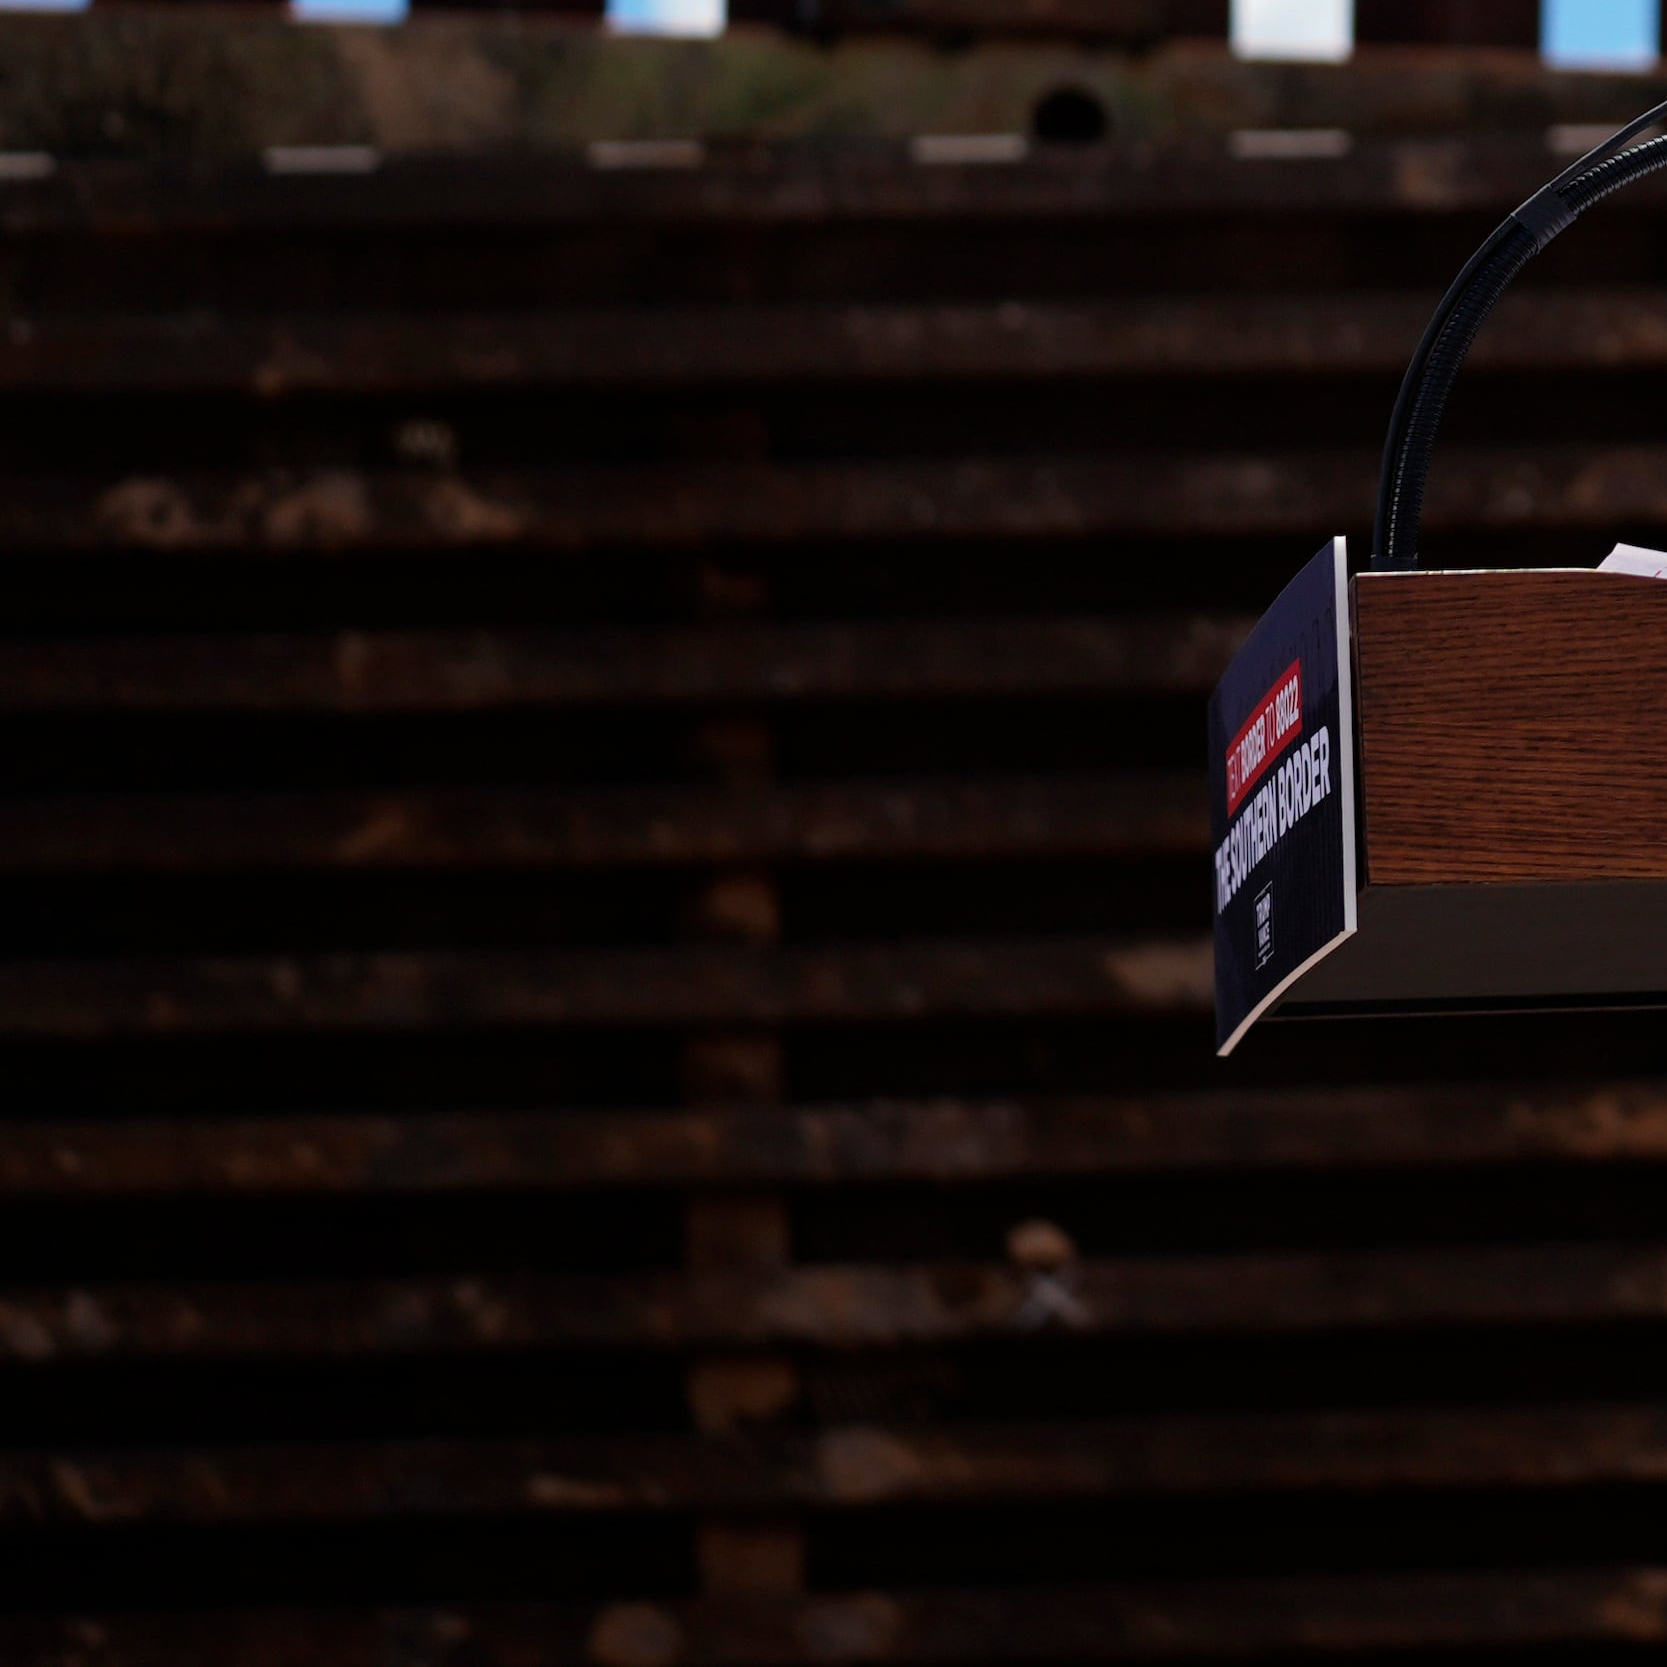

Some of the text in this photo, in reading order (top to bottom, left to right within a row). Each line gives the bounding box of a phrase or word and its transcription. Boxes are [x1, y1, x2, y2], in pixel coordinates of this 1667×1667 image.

[1227, 675, 1299, 801] TEXT BORDER TO 88022
[1215, 725, 1331, 915] THE SOUTHERN BORDER
